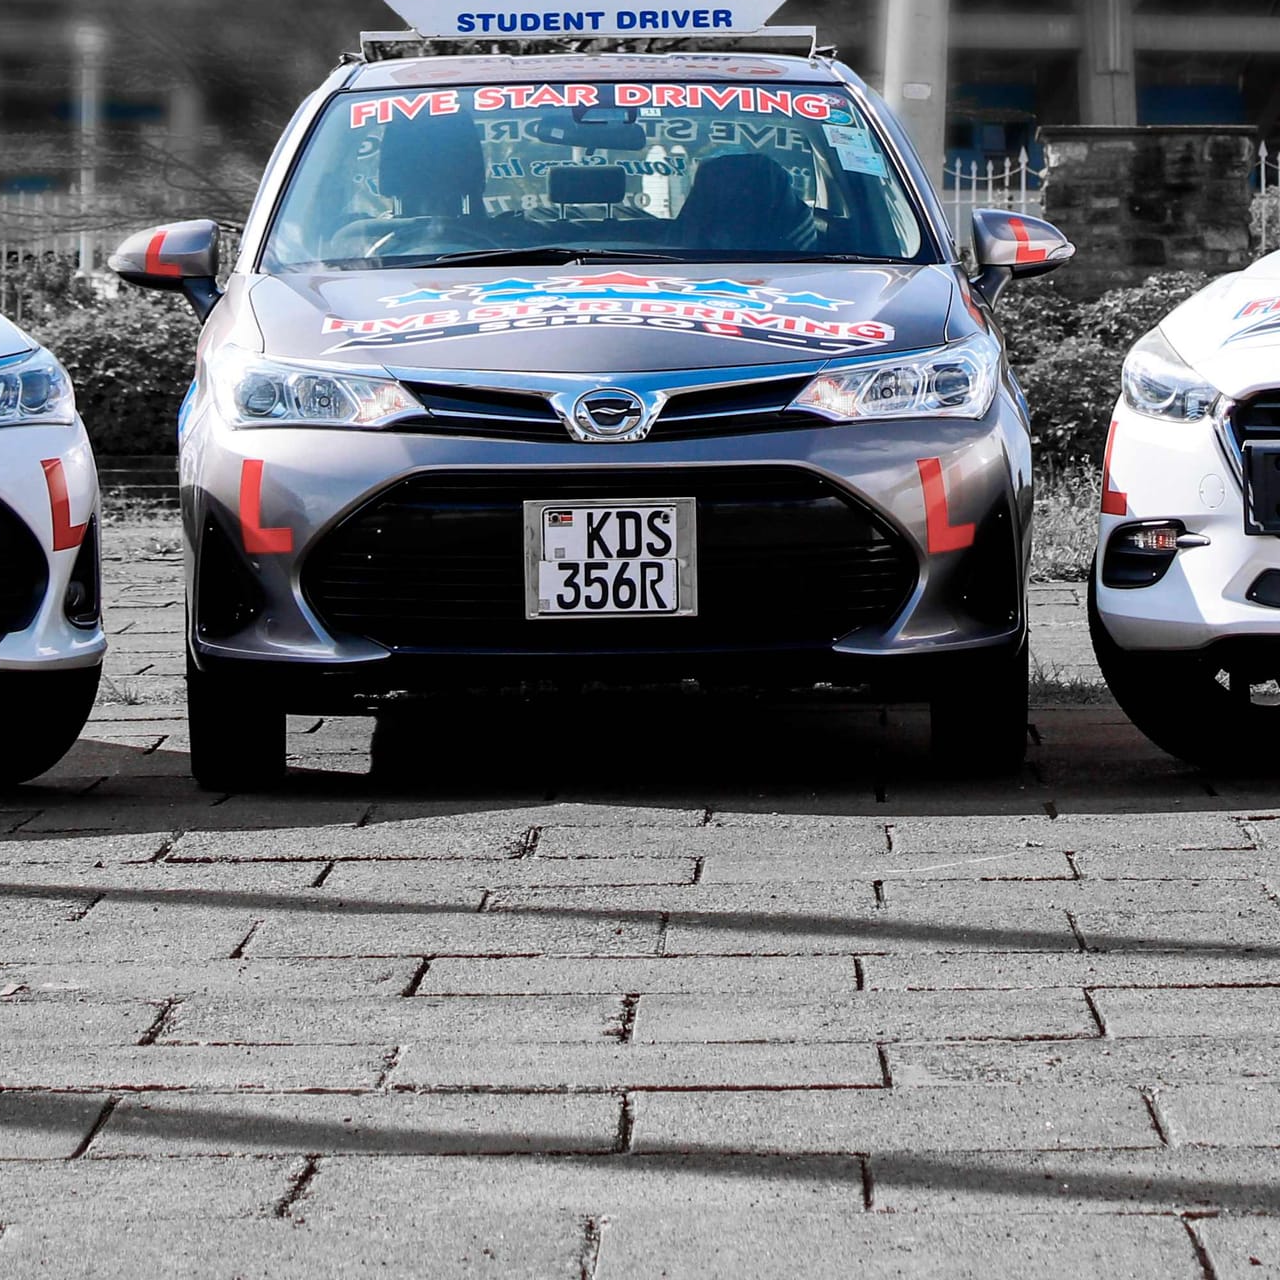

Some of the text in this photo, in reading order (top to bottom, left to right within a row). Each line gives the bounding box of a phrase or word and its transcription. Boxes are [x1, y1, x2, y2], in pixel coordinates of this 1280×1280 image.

[457, 10, 732, 32] STUDENT DRIVER
[350, 84, 831, 128] FIVE STAR DRIVING
[145, 231, 181, 278] L
[1009, 218, 1046, 263] L
[322, 309, 461, 334] FIVE
[631, 301, 895, 341] DRIVING
[477, 314, 744, 336] SCHOOL
[40, 457, 87, 552] L
[238, 459, 293, 553] L
[916, 458, 975, 553] L
[587, 510, 672, 558] KDS
[556, 561, 668, 609] 356R
